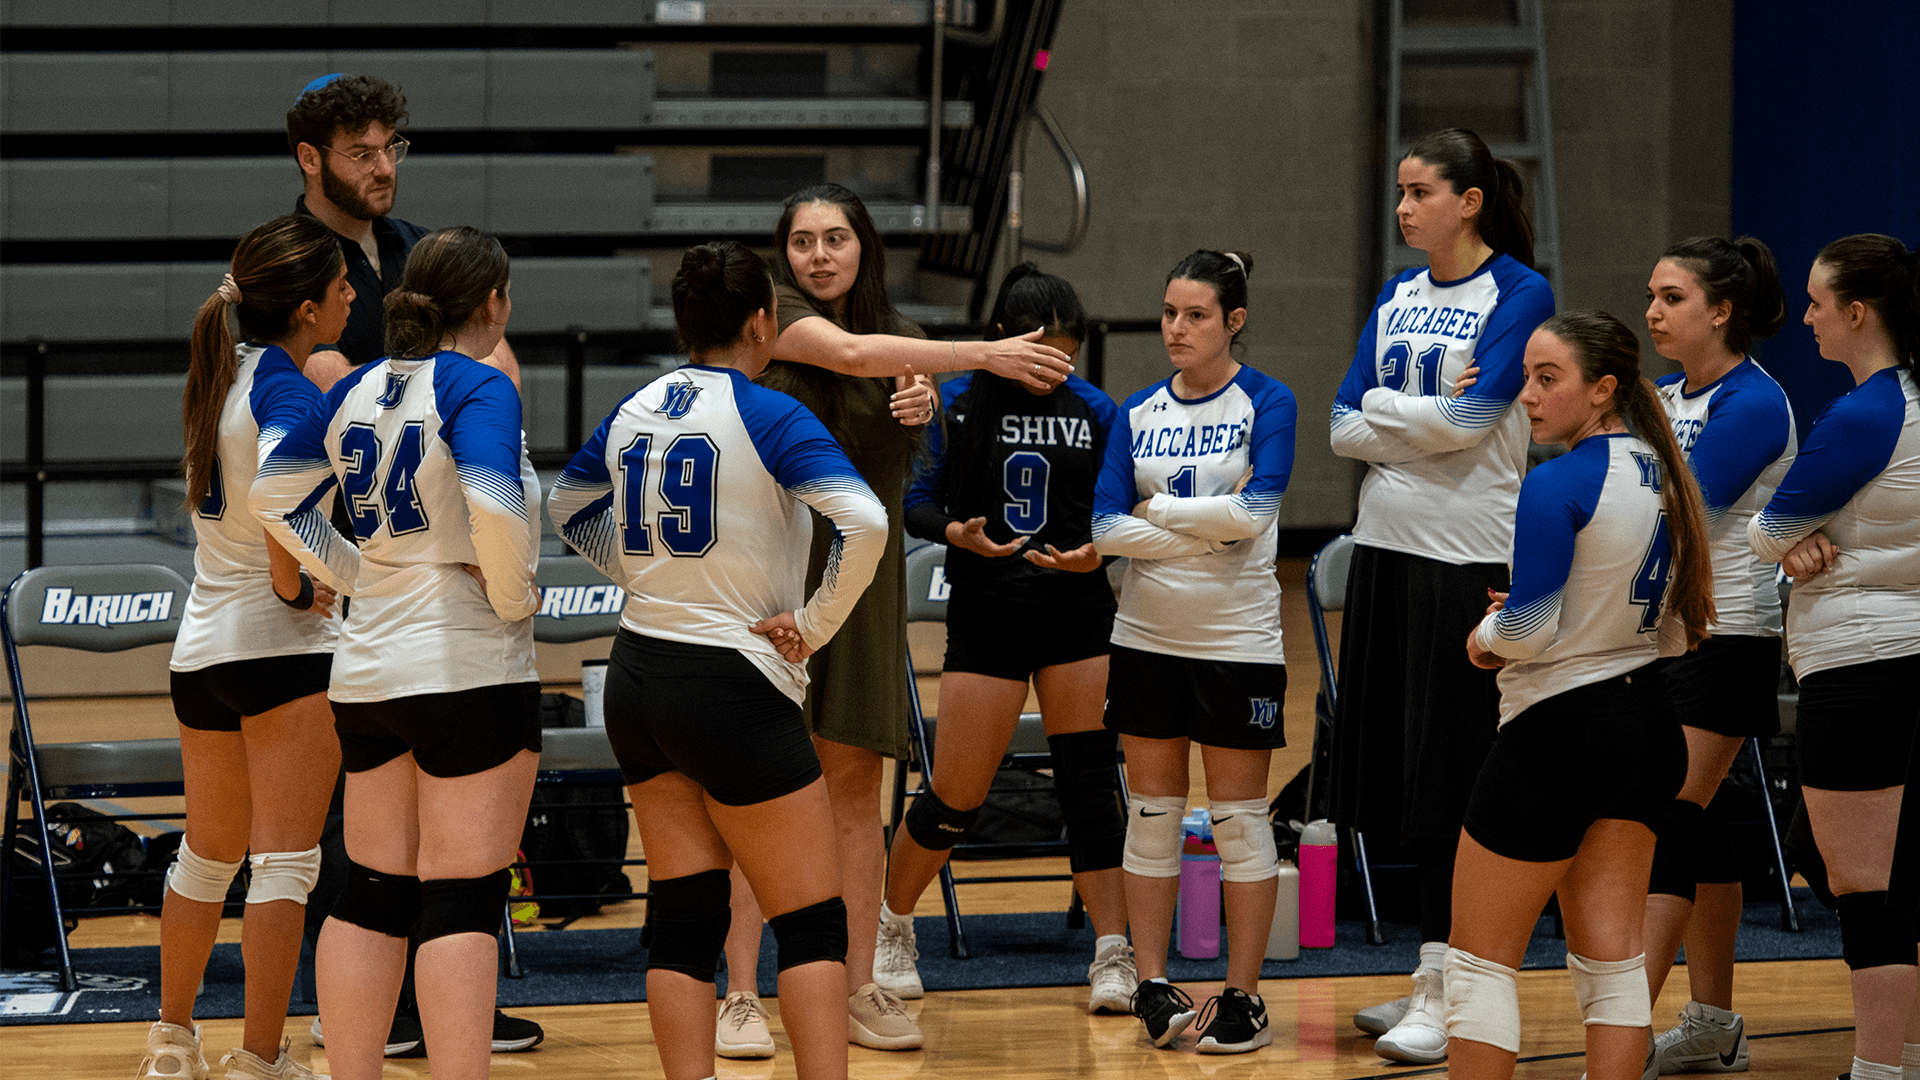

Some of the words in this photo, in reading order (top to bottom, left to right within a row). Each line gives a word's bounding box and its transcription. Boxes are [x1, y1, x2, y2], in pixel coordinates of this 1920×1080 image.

[1380, 340, 1448, 397] 21
[654, 381, 704, 420] YU
[996, 414, 1093, 449] SHIVA
[339, 420, 429, 541] 24
[618, 432, 721, 558] 19
[1003, 451, 1051, 534] 9
[1629, 508, 1675, 633] 4
[537, 584, 626, 621] RUCH
[1249, 697, 1278, 729] YU
